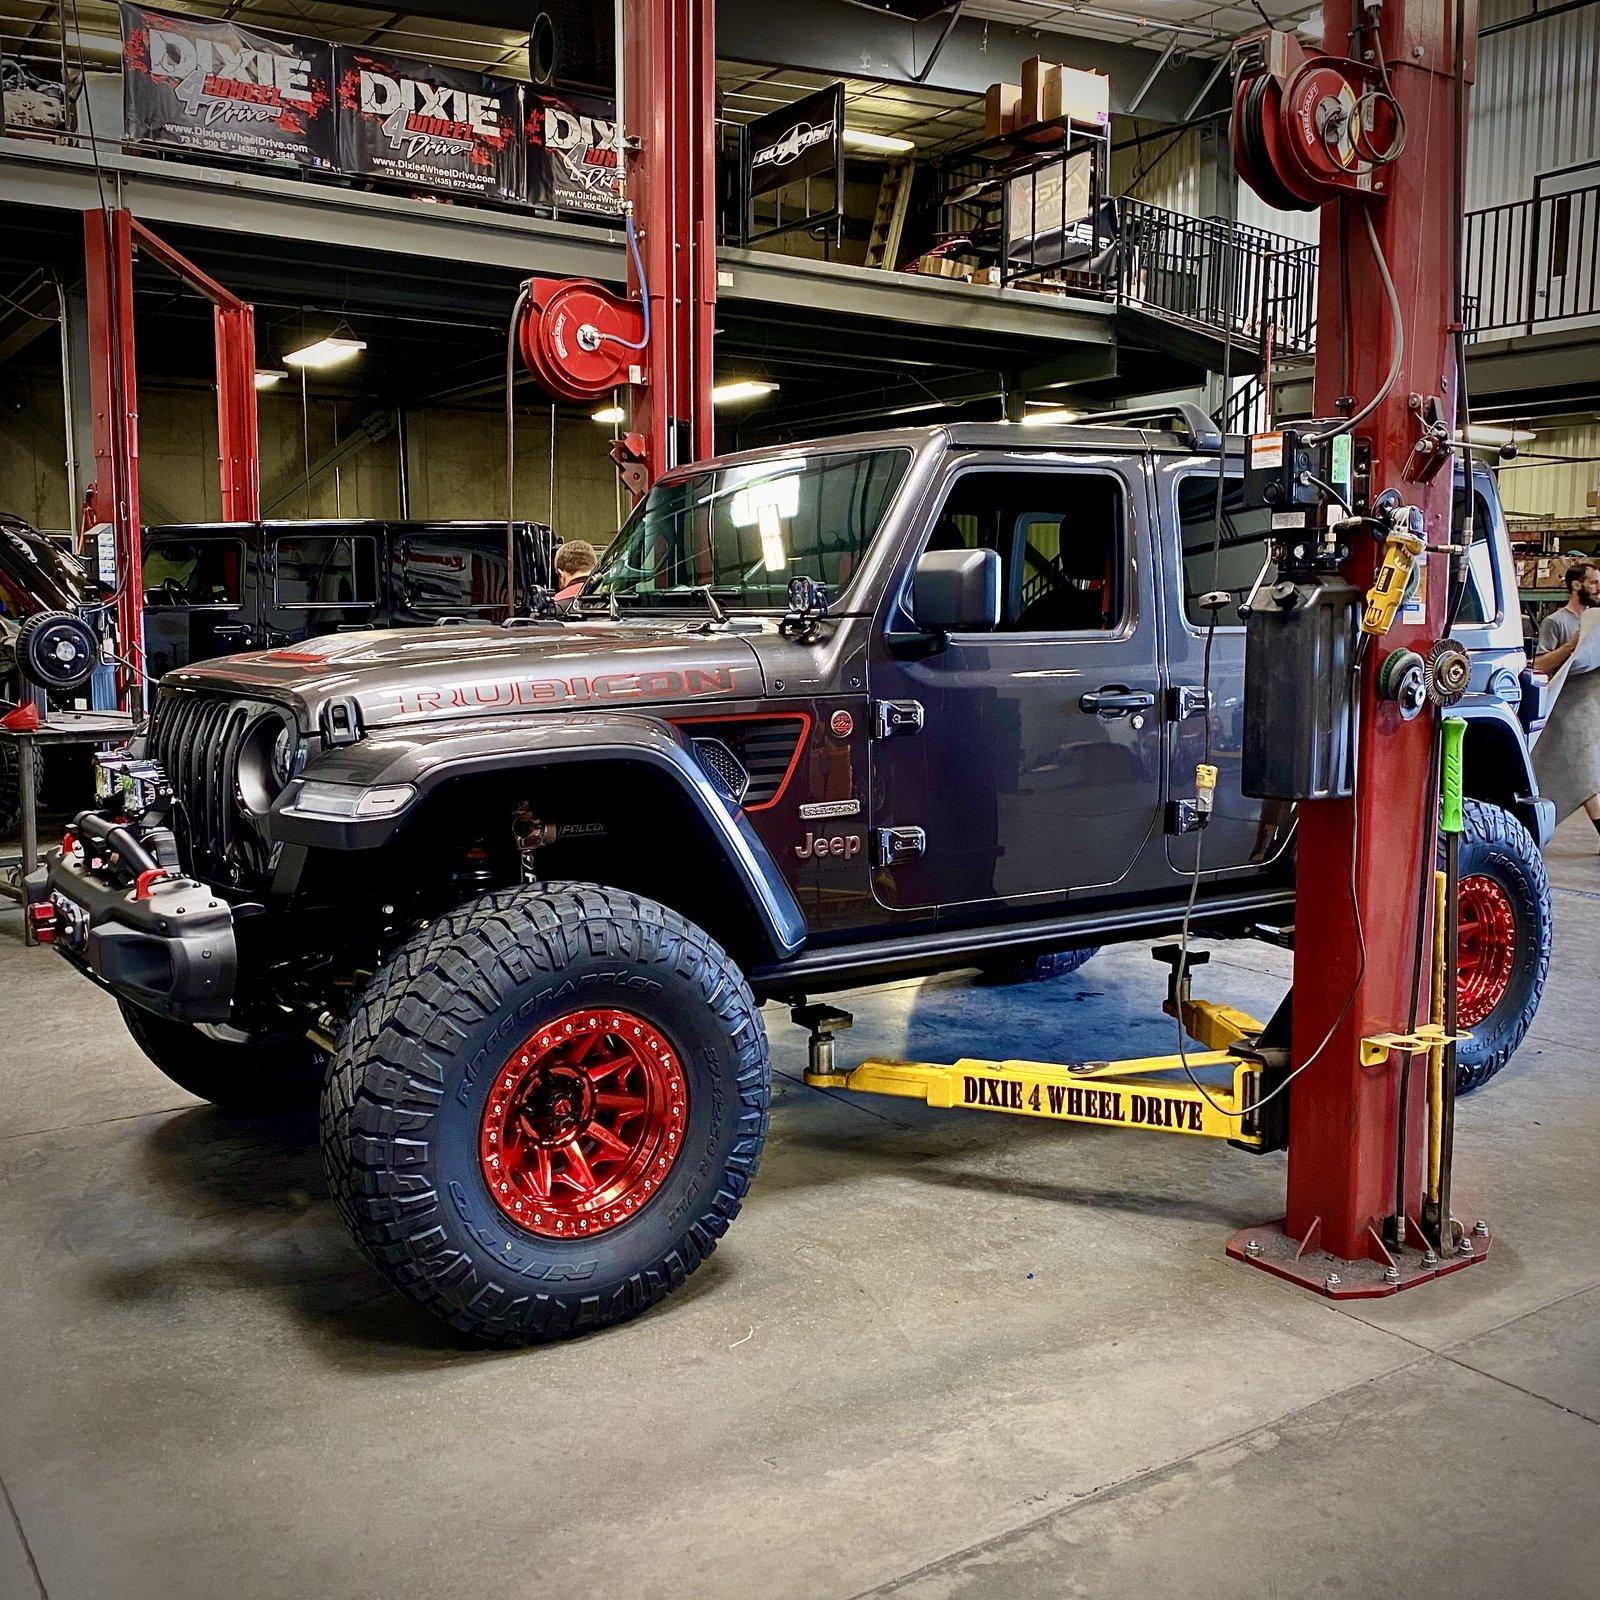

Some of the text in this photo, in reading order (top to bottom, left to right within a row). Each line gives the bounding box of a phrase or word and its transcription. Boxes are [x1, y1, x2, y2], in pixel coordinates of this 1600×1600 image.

[149, 29, 312, 101] DIXIE
[203, 75, 281, 106] WHEEL
[360, 70, 501, 137] DIXIE
[204, 99, 270, 126] Drive
[407, 115, 474, 141] WHEEL
[163, 123, 308, 154] www.Dixie4WheelDrive.com
[545, 107, 617, 150] DIX
[406, 135, 464, 159] Drive
[372, 157, 496, 184] www.Dixie4WheelDrive.com
[405, 171, 418, 179] 900
[434, 176, 451, 187] (435)
[453, 179, 485, 190] 673-2546
[400, 668, 735, 714] RUBICON
[795, 832, 861, 859] Jeep
[963, 1075, 1203, 1131] DIXIE 4 WHEEL DRIVE
